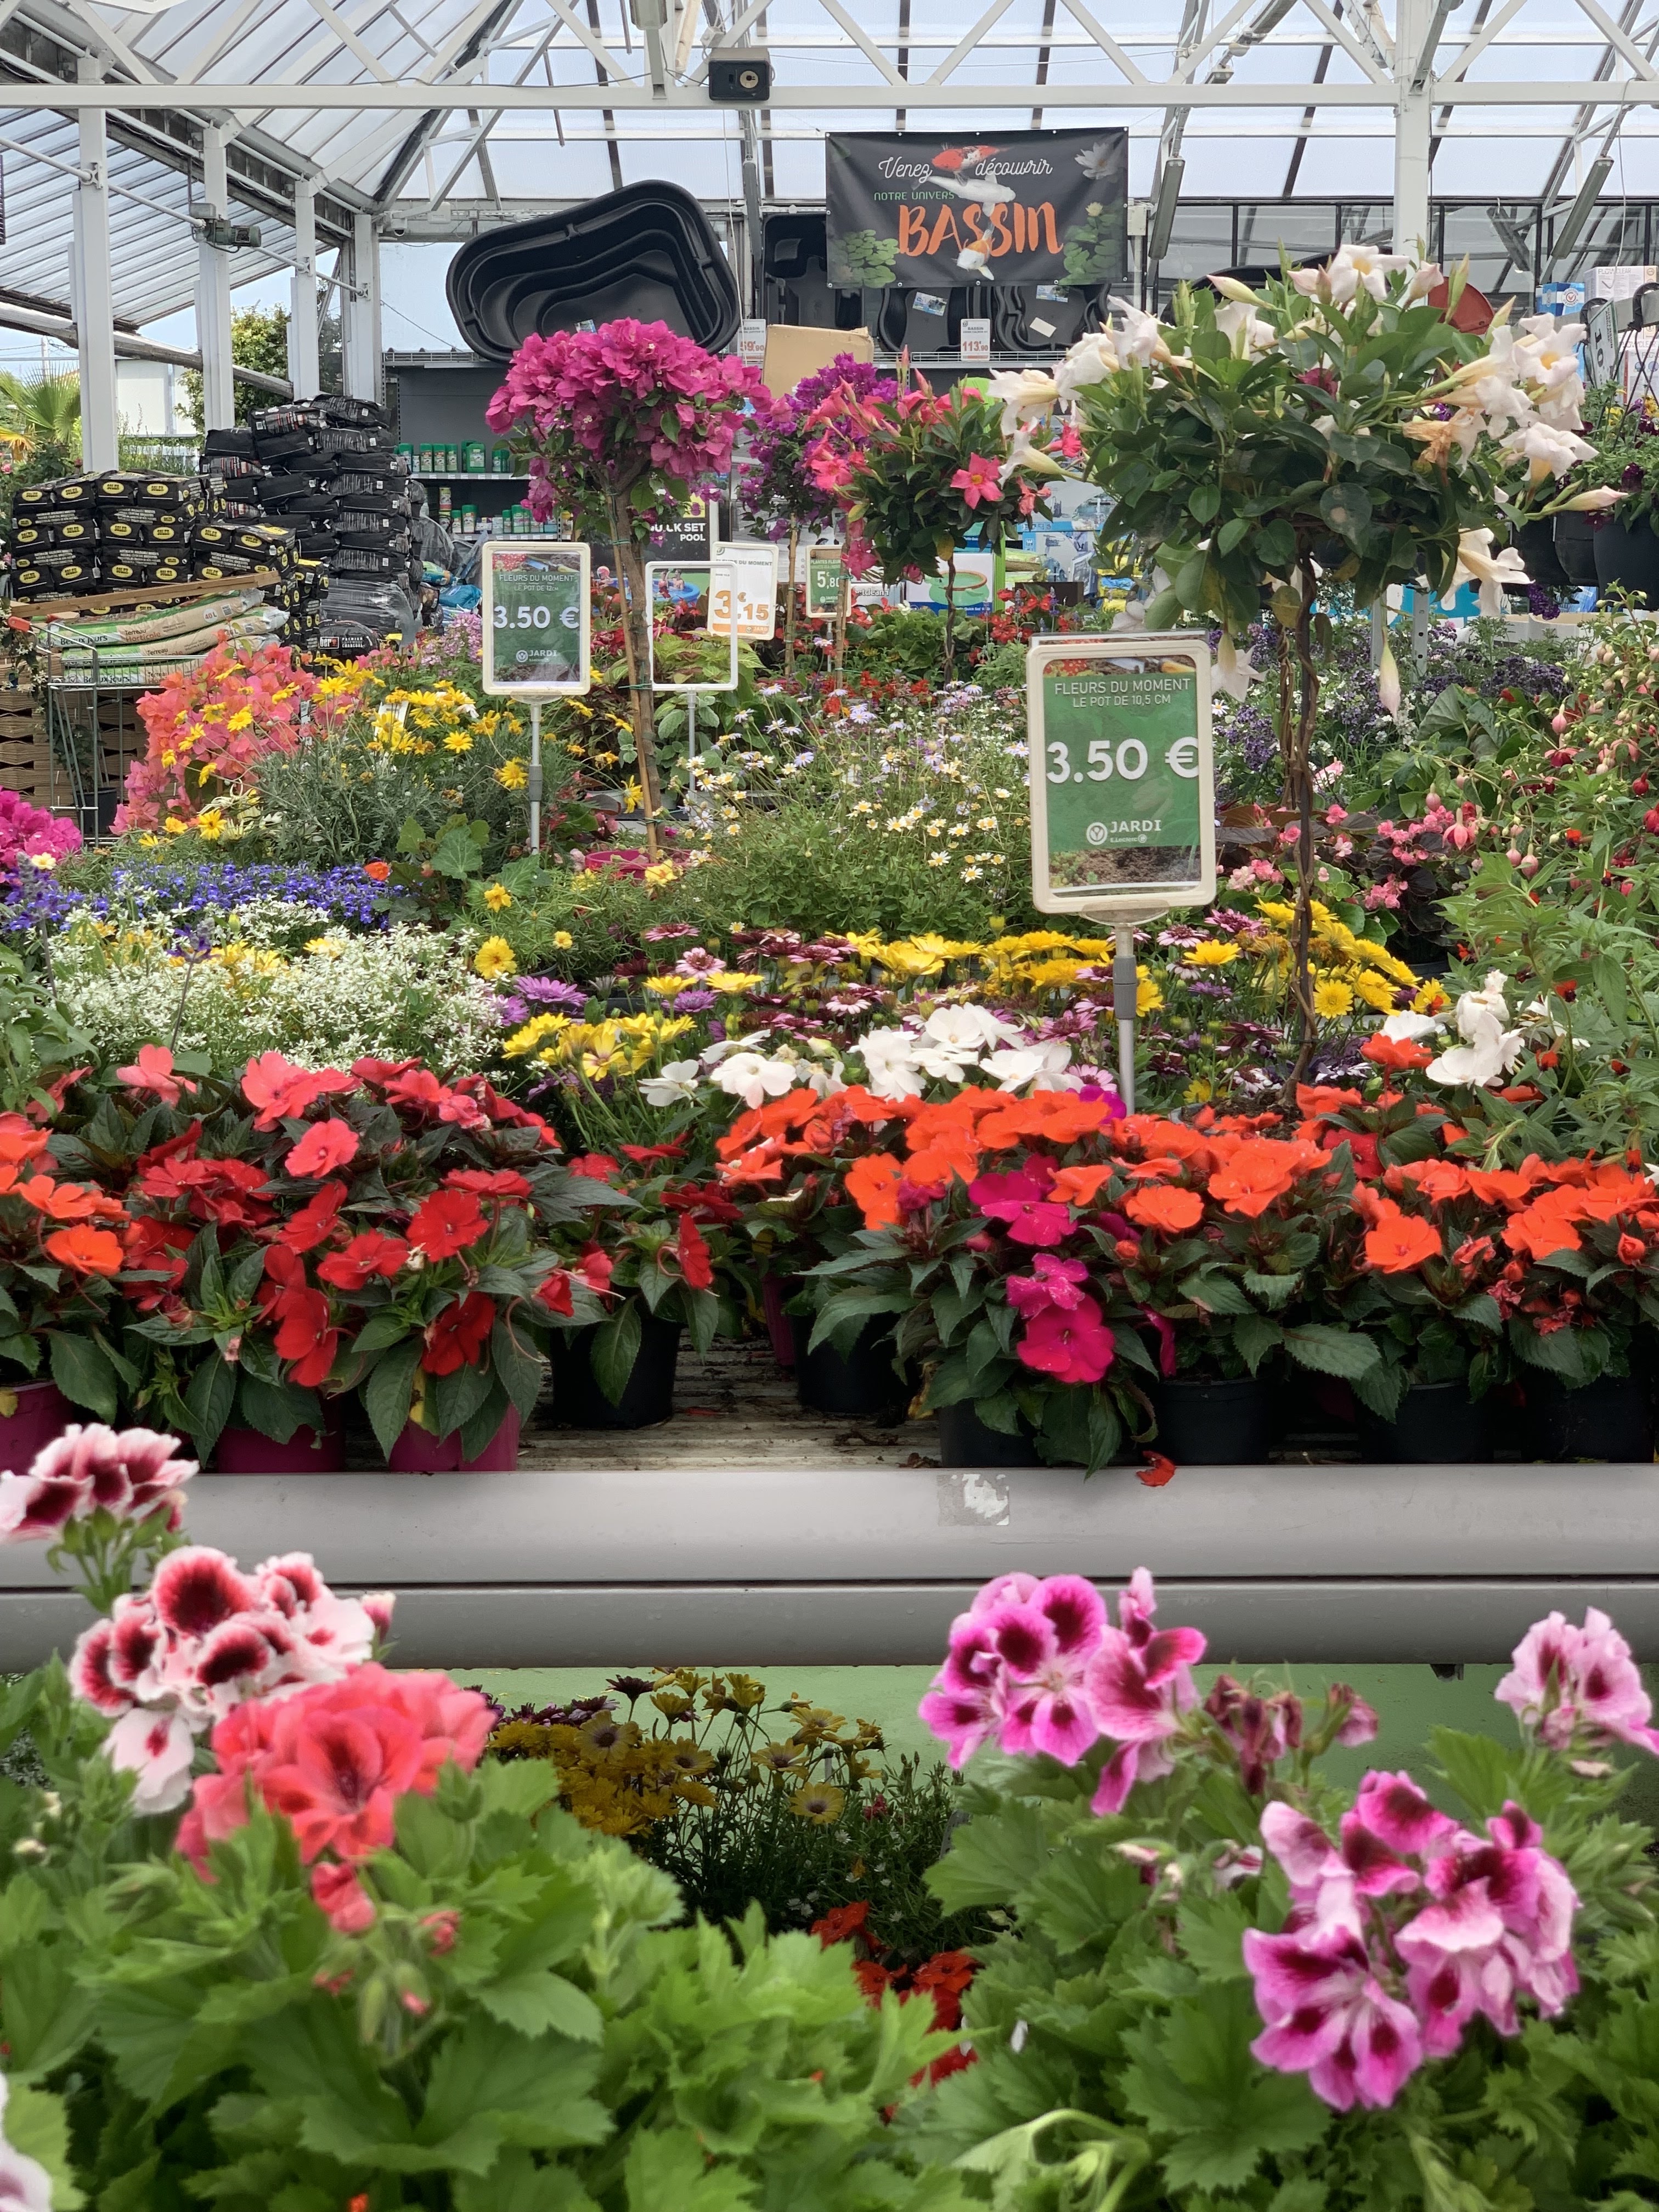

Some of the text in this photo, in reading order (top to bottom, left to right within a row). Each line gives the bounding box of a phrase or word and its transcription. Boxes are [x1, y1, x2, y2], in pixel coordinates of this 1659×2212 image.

[878, 156, 1053, 183] Venez découvrir
[874, 191, 955, 201] NOTRE UNIVERS
[899, 201, 1064, 257] BASSIN
[684, 523, 706, 532] SET
[493, 606, 580, 629] 3.50 €
[126, 632, 161, 642] Horticole
[1054, 678, 1190, 695] FLEURS DU MOMENT
[1073, 693, 1171, 708] LE POT DE 10,5 CM
[1046, 736, 1199, 784] 3.50 €
[1110, 820, 1161, 833] JARDI
